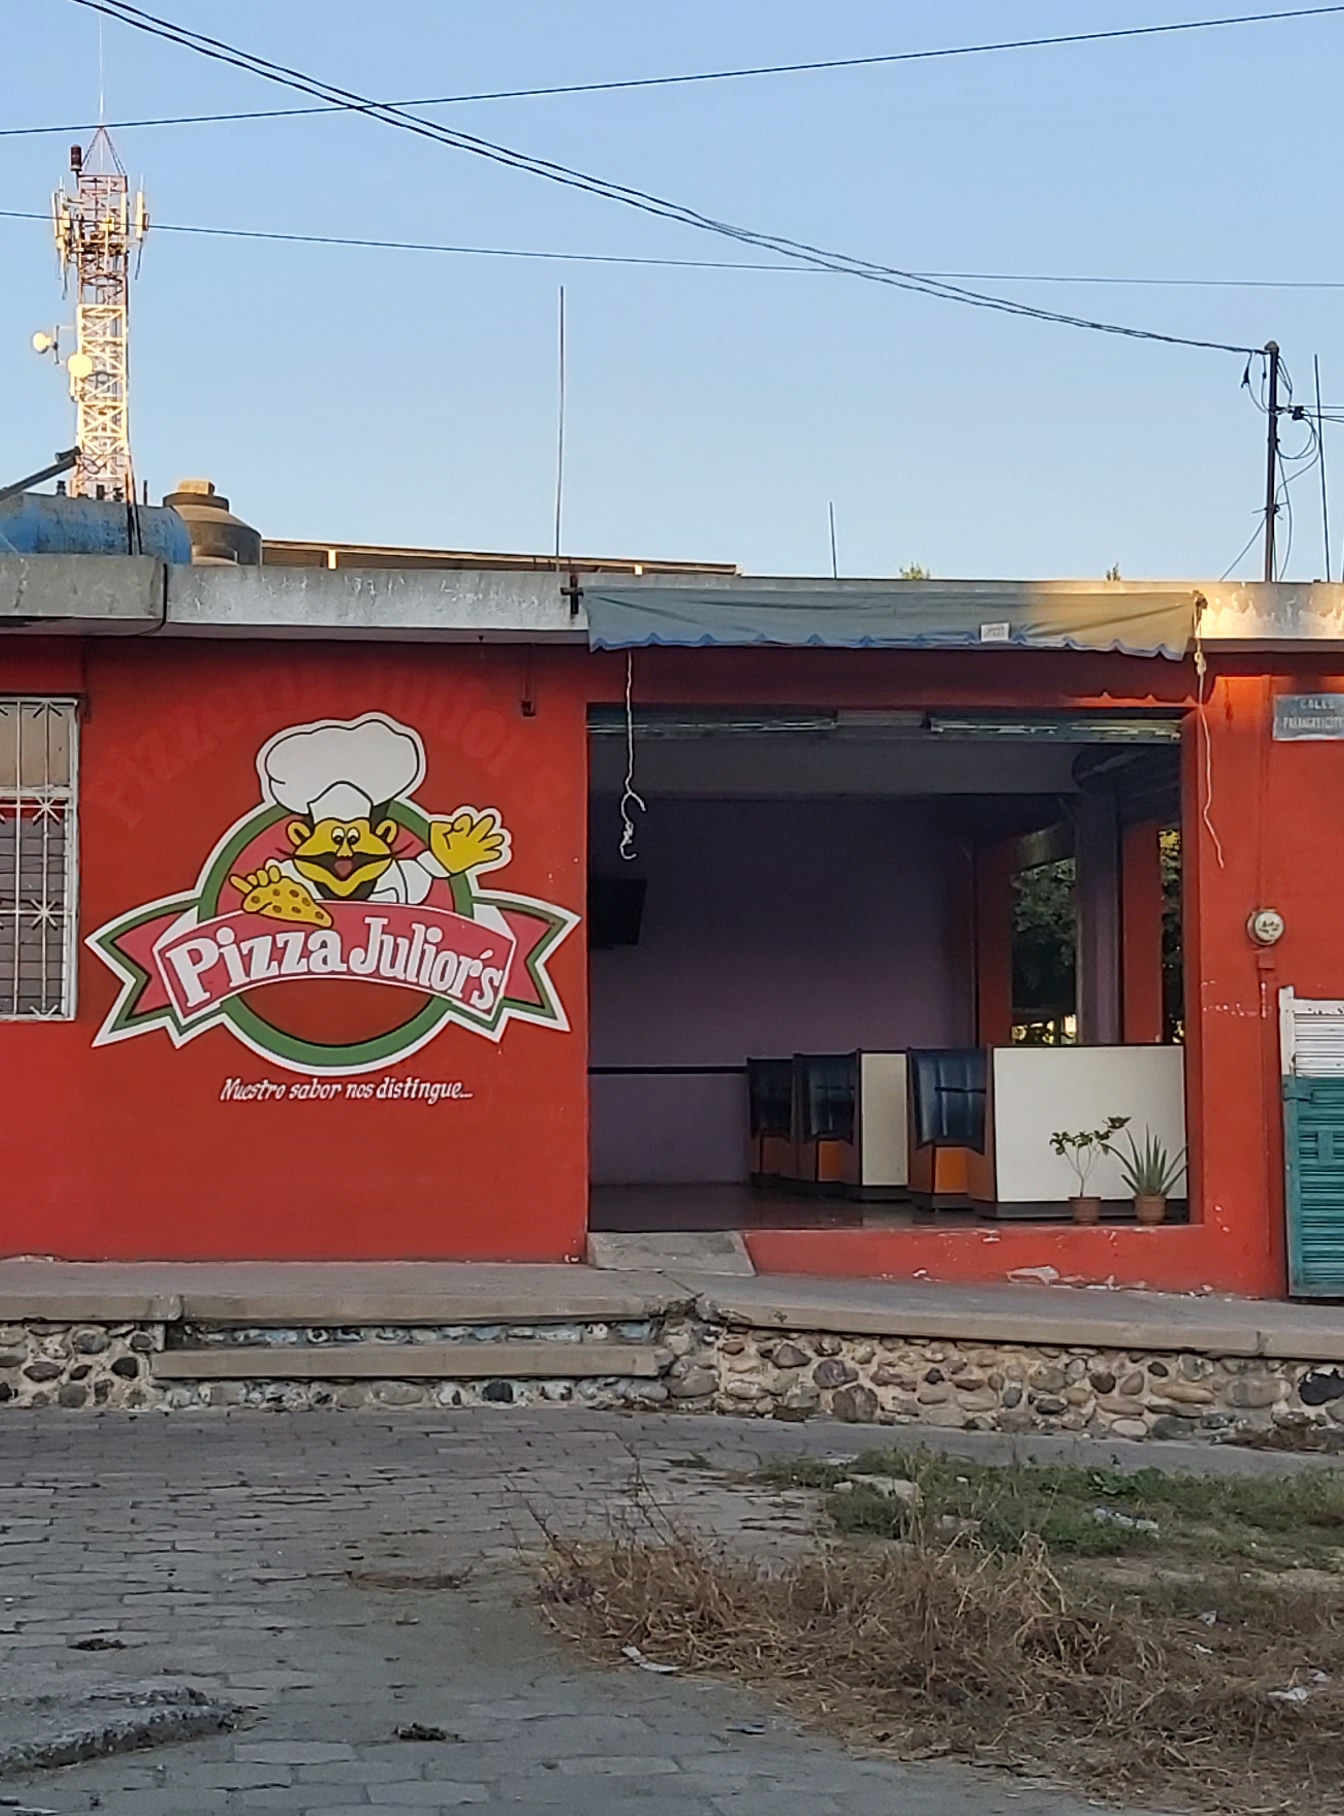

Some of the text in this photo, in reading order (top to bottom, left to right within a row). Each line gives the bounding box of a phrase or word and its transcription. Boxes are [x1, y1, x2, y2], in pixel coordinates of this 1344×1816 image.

[165, 916, 505, 1011] Pizza Julior's
[220, 1077, 285, 1101] Nuestro
[288, 1078, 344, 1100] sabor
[345, 1081, 375, 1100] nos
